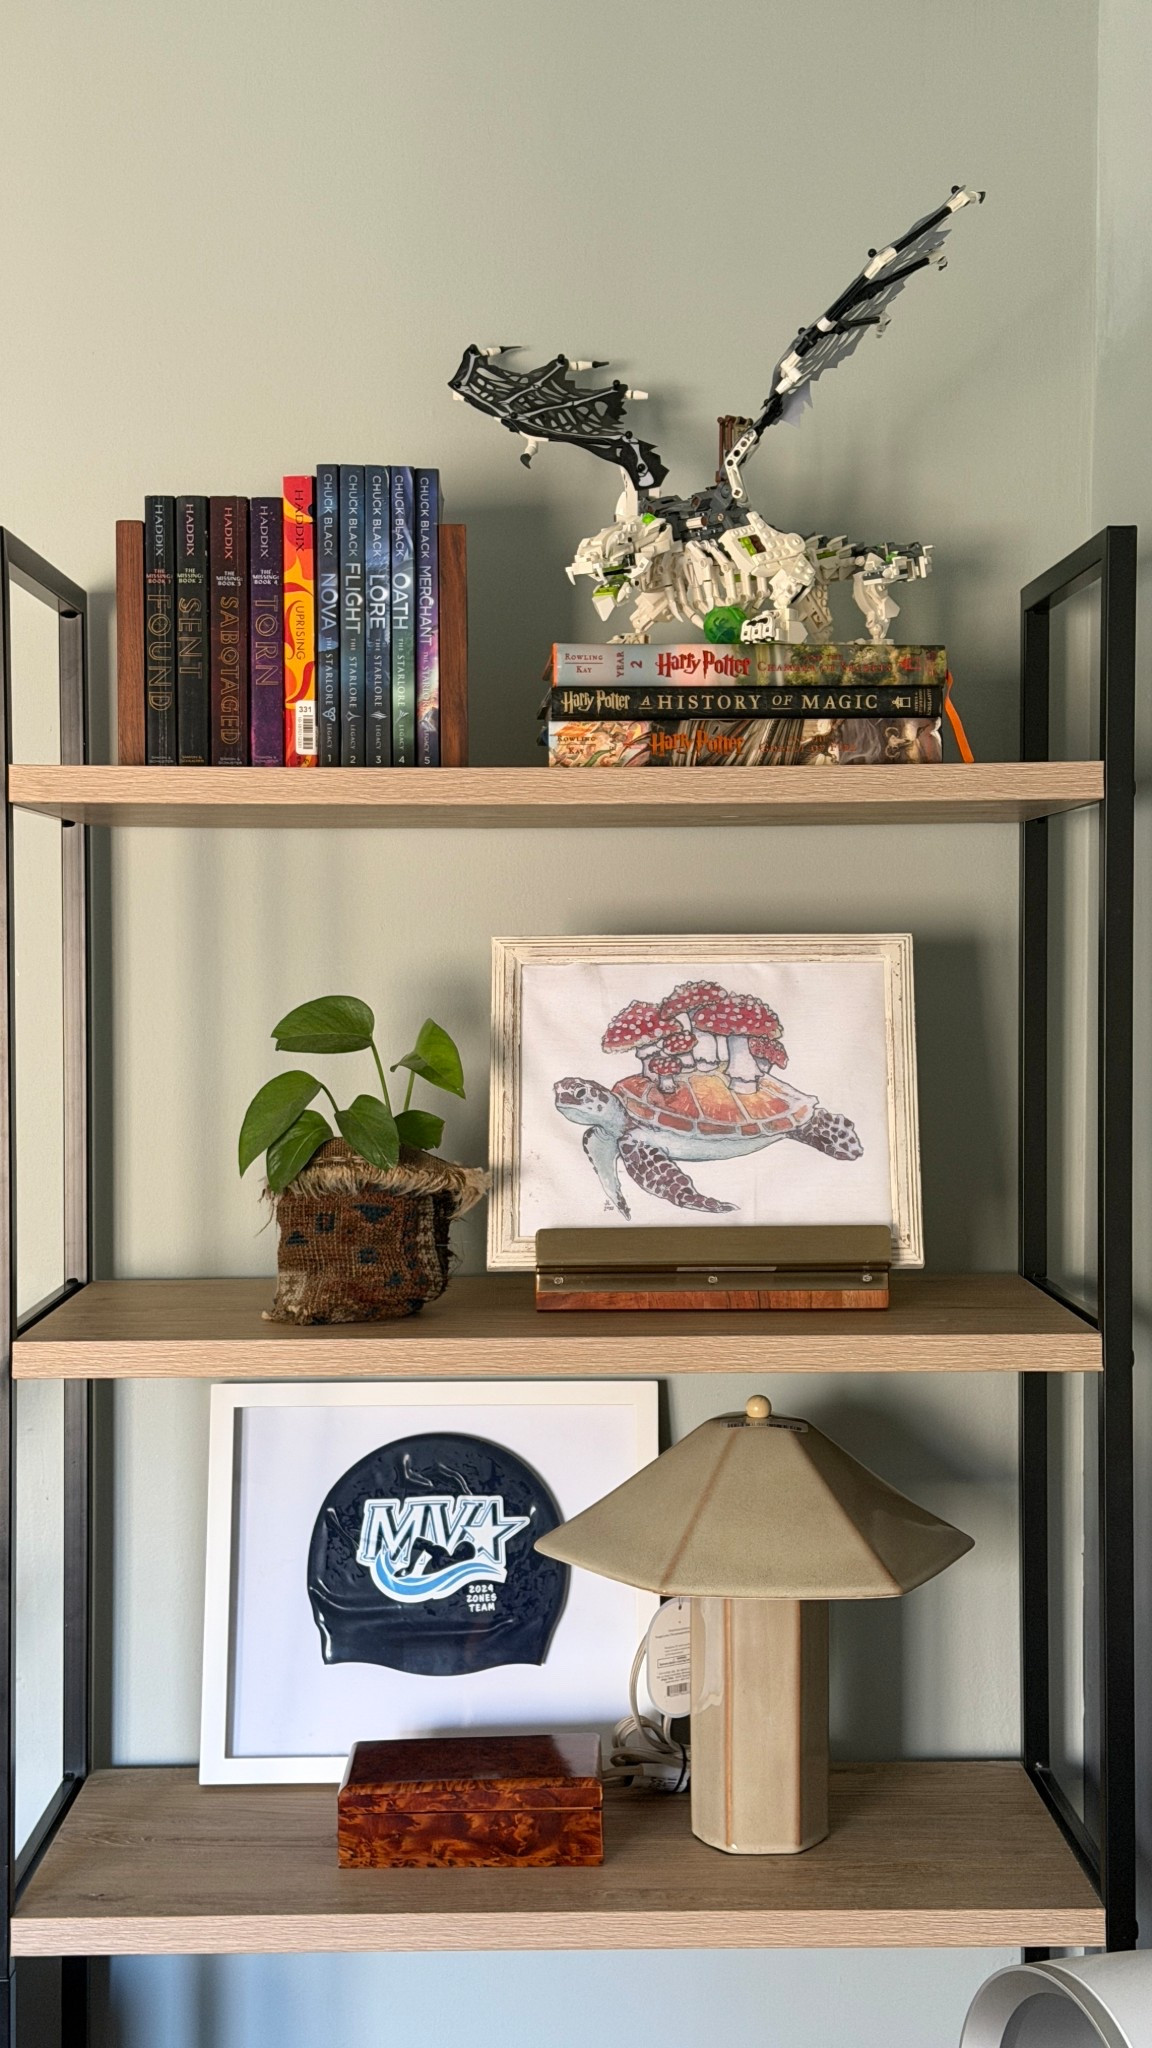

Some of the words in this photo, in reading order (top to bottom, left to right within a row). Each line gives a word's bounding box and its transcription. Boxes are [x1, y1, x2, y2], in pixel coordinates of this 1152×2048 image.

[324, 474, 332, 514] CHUCK
[348, 474, 358, 514] CHUCK
[372, 476, 382, 516] CHUCK
[394, 475, 404, 515] CHUCK
[420, 478, 429, 516] CHUCK
[155, 504, 164, 557] HADDIX
[185, 503, 195, 556] HADDIX
[224, 507, 233, 559] HADDIX
[259, 506, 269, 558] HADDIX
[295, 490, 304, 552] HADDIX
[324, 517, 333, 556] BLACK
[348, 518, 358, 557] BLACK
[372, 519, 382, 557] BLACK
[395, 518, 404, 557] BLACK
[420, 520, 430, 558] BLACK
[320, 574, 338, 630] NOVA
[345, 563, 362, 634] FLIGHT
[370, 575, 389, 629] LORE
[392, 573, 410, 630] OATH
[419, 566, 434, 646] MERCHANT
[148, 594, 172, 711] FOUND
[178, 597, 202, 679] SENT
[255, 595, 279, 686] TORN
[296, 606, 305, 660] UPRISING
[220, 596, 240, 744] SABOTAGED
[325, 654, 334, 705] STARLORE
[350, 656, 358, 708] STARLORE
[374, 655, 382, 707] STARLORE
[398, 655, 406, 706] STARLORE
[576, 666, 592, 674] KAY
[616, 652, 624, 678] YEAR
[630, 660, 642, 668] 2
[656, 652, 701, 678] Harry
[702, 650, 751, 679] Potter
[560, 690, 594, 714] Harry
[596, 690, 630, 714] Potter
[640, 698, 650, 706] A
[657, 694, 762, 710] HISTORY
[772, 695, 793, 706] OF
[802, 694, 878, 710] MAGIC
[350, 756, 356, 764] 2
[376, 756, 382, 764] 3
[398, 756, 405, 764] 4
[650, 732, 691, 757] Harry
[696, 729, 746, 757] Potter
[466, 1593, 498, 1602] ZONES
[468, 1584, 494, 1594] 2024
[468, 1602, 496, 1612] TEAM
